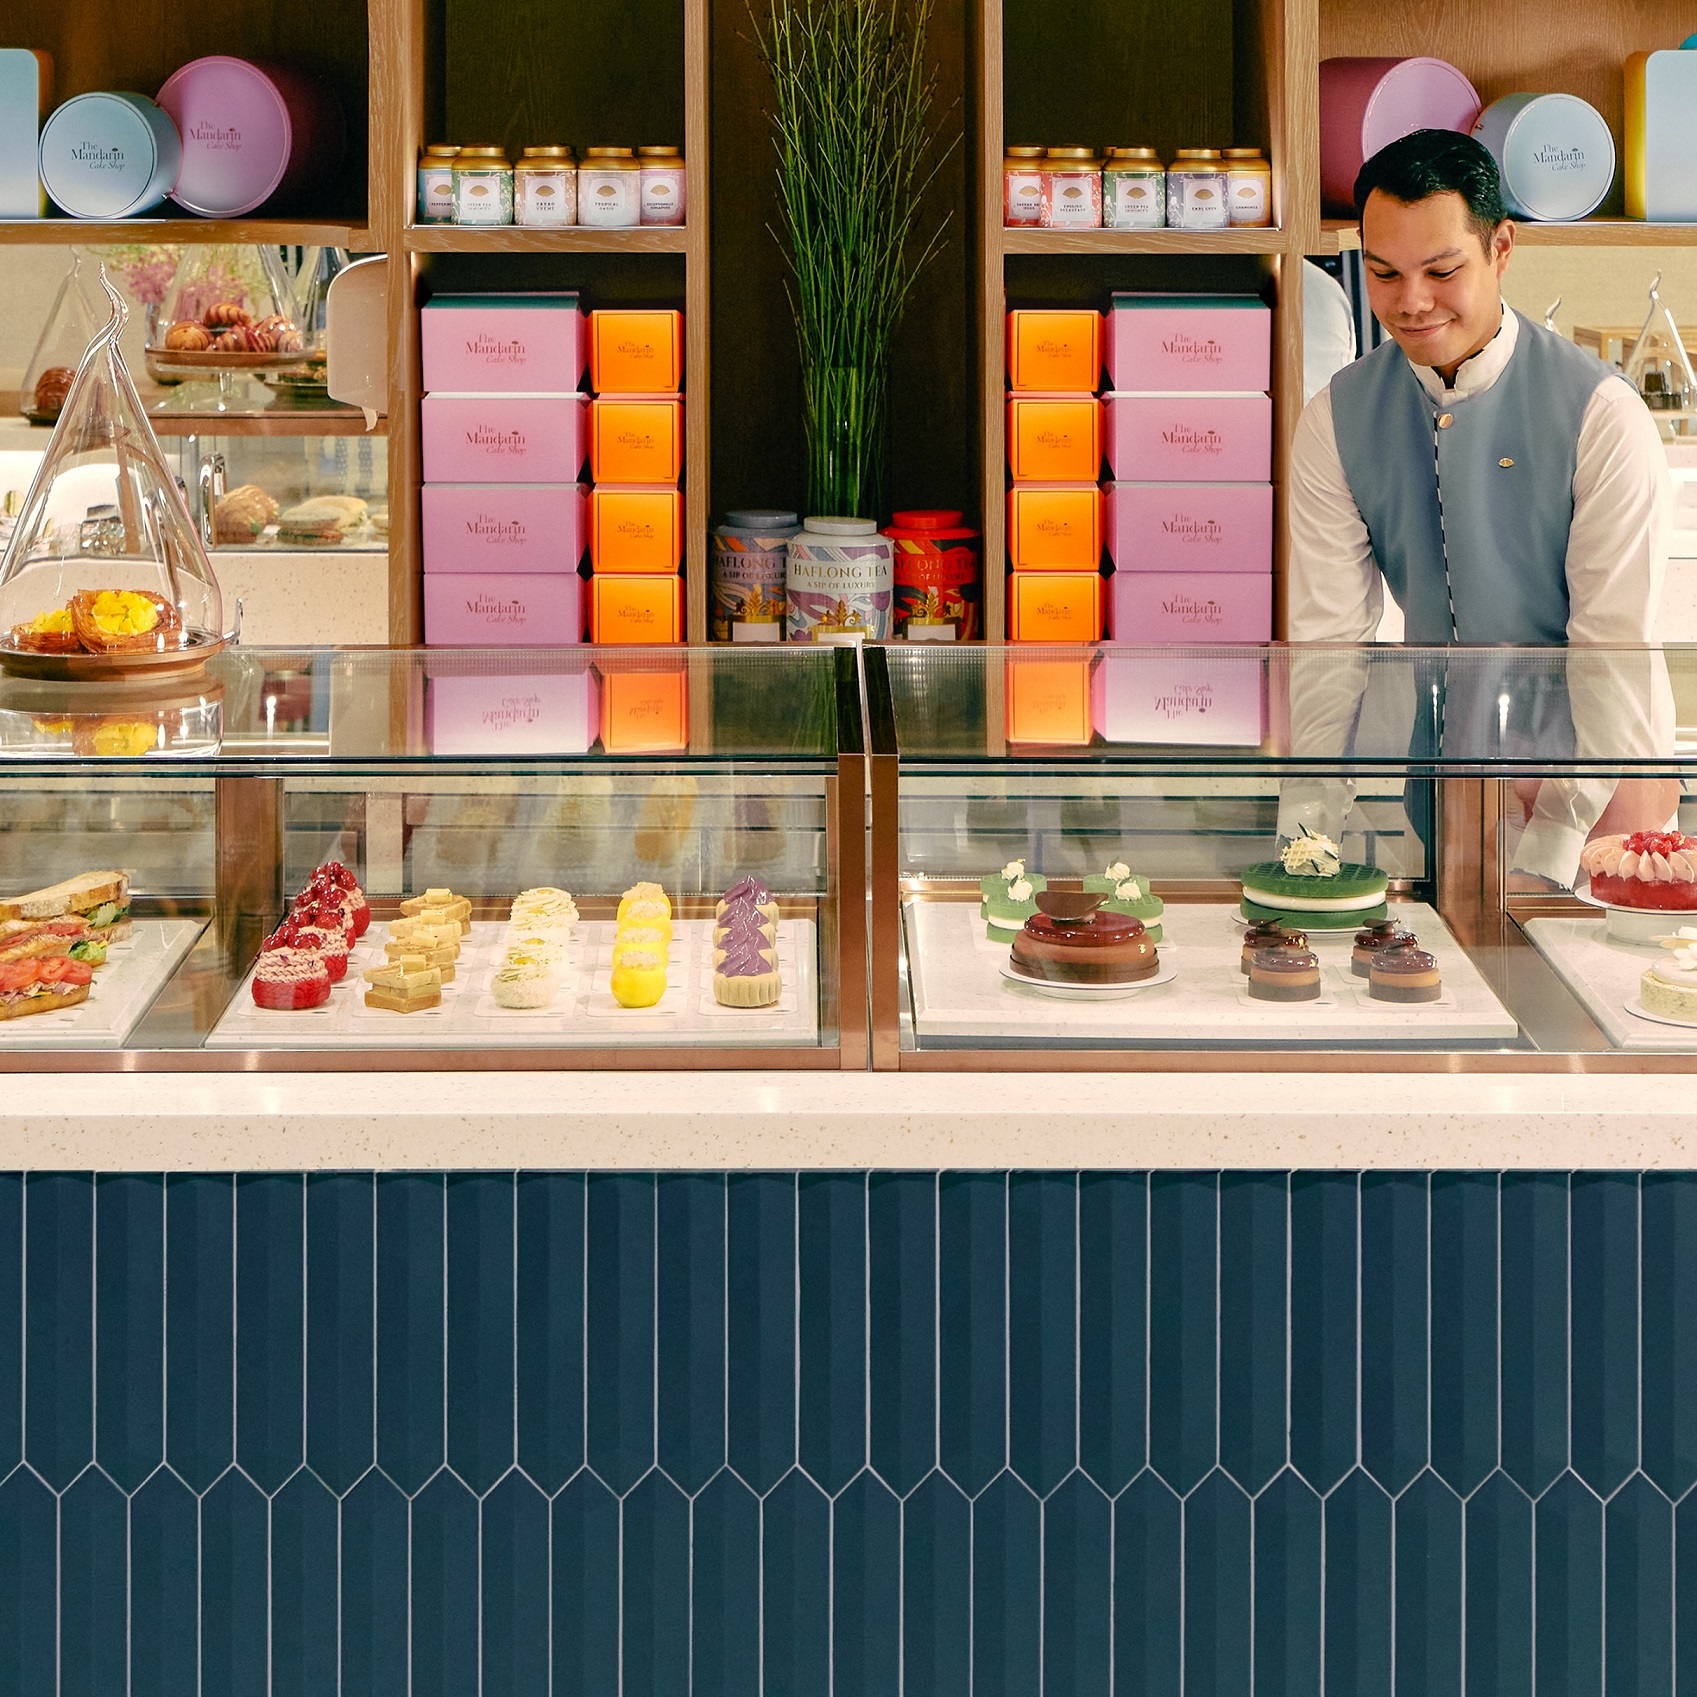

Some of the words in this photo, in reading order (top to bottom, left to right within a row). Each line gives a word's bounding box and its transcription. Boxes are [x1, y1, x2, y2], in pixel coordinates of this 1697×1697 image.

[199, 121, 215, 130] The
[189, 127, 241, 141] Mandarin
[81, 142, 97, 150] The
[207, 142, 224, 150] Cake
[225, 141, 242, 152] Shop
[1543, 143, 1559, 153] The
[71, 147, 124, 161] Mandarin
[1533, 147, 1585, 164] Mandarin
[108, 161, 125, 171] Shop
[1550, 162, 1567, 171] Cake
[1569, 161, 1586, 171] Shop
[477, 334, 495, 343] The
[1173, 333, 1191, 342] The
[465, 340, 526, 355] Mandarin
[617, 344, 654, 354] Mandarin
[1162, 339, 1222, 354] Mandarin
[486, 355, 505, 364] Cake
[507, 355, 526, 365] Shop
[1182, 355, 1201, 363] Cake
[1203, 354, 1223, 365] Shop
[477, 424, 495, 434] The
[1173, 424, 1191, 433] The
[465, 431, 526, 446] Mandarin
[1162, 430, 1222, 445] Mandarin
[477, 514, 495, 523] The
[1173, 513, 1191, 522] The
[465, 520, 526, 535] Mandarin
[1162, 519, 1222, 534] Mandarin
[714, 555, 776, 568] HAFLONG
[794, 564, 862, 578] HAFLONG
[867, 565, 887, 577] TEA
[829, 582, 840, 590] OF
[477, 594, 495, 603] The
[1173, 594, 1191, 603] The
[465, 600, 526, 615] Mandarin
[1162, 600, 1222, 615] Mandarin
[486, 615, 505, 624] Cake
[507, 615, 526, 626] Shop
[1182, 615, 1201, 624] Cake
[1203, 615, 1223, 626] Shop
